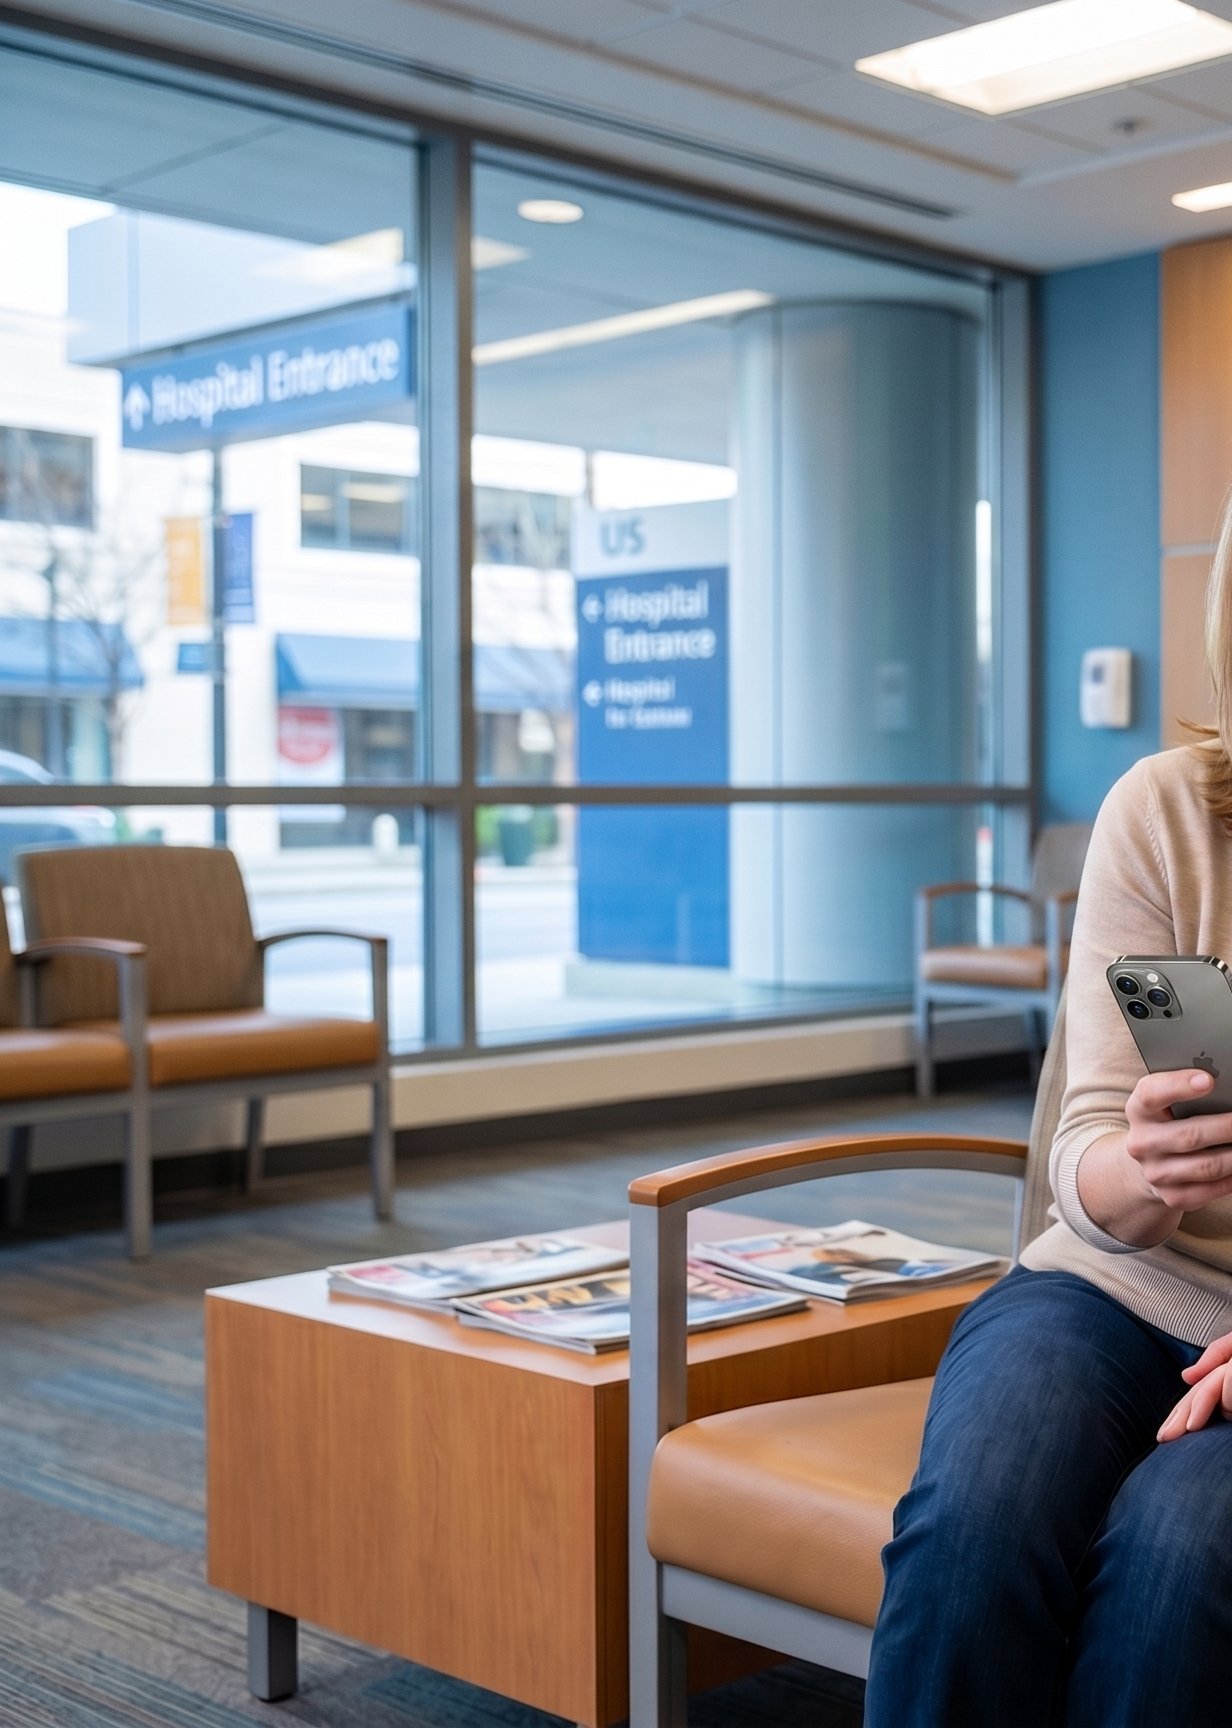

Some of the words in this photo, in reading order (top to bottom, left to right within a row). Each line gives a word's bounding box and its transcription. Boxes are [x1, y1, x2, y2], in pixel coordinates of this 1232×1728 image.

[152, 354, 264, 428] Hospital
[267, 337, 400, 402] Entrance
[601, 515, 646, 557] US
[604, 579, 709, 628] Hospital
[604, 627, 716, 664] Entrance
